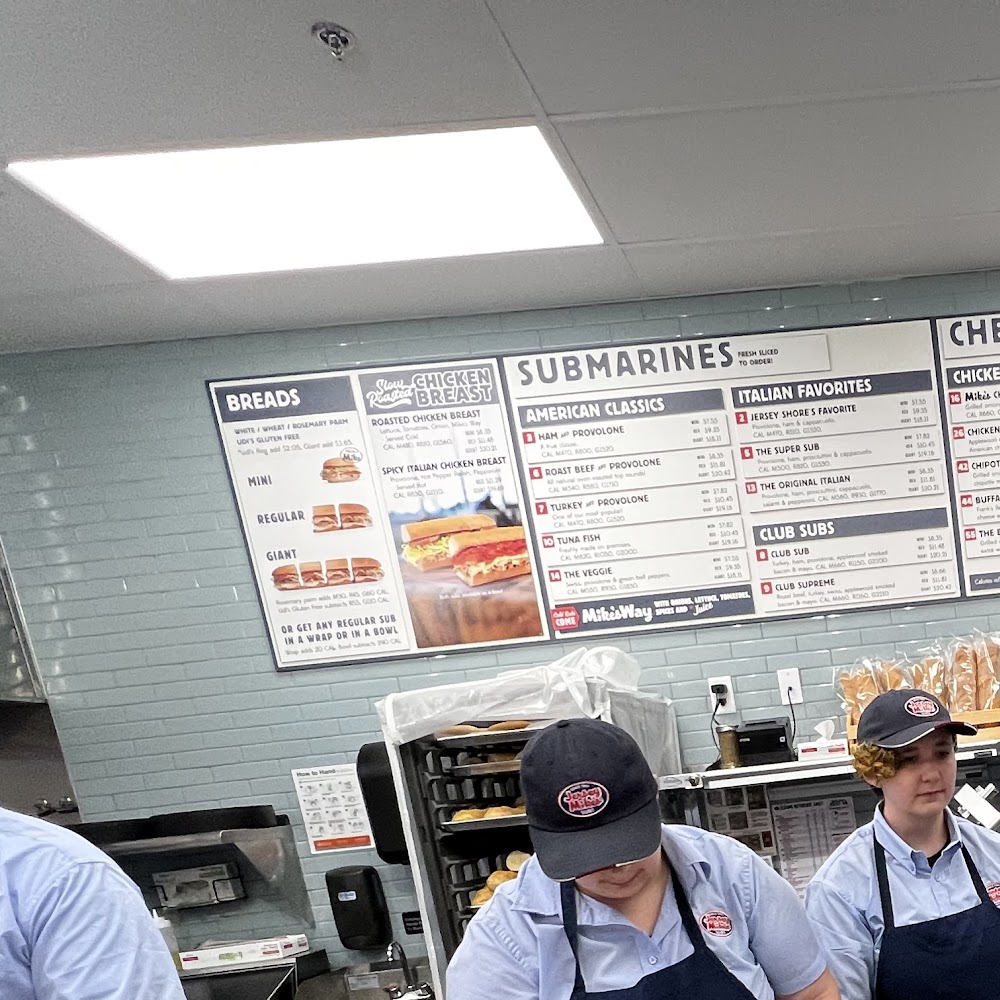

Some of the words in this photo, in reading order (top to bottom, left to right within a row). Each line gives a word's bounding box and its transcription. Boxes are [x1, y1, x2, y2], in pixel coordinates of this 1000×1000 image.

[738, 350, 757, 358] FRESH
[759, 348, 779, 357] SLICED
[517, 341, 733, 386] SUBMARINES
[750, 358, 774, 366] ORDER!
[376, 378, 404, 395] Slow
[412, 368, 491, 390] CHICKEN
[366, 383, 415, 408] Roasted
[415, 384, 492, 407] BREAST
[738, 386, 794, 404] ITALIAN
[798, 378, 872, 399] FAVORITES
[226, 388, 301, 412] BREADS
[371, 415, 410, 427] ROASTED
[412, 412, 448, 423] CHICKEN
[450, 409, 481, 420] BREAST
[526, 404, 601, 423] AMERICAN
[604, 397, 665, 416] CLASSICS
[751, 411, 779, 422] JERSEY
[818, 404, 857, 415] FAVORITE
[234, 427, 255, 435] WHITE
[262, 424, 285, 433] WHEAT
[292, 420, 327, 430] ROSEMARY
[329, 418, 349, 426] PARM
[538, 431, 559, 441] HAM
[572, 426, 625, 438] PROVOLONE
[967, 425, 1000, 436] CHICKEN
[256, 435, 282, 444] GLUTEN
[284, 433, 300, 441] FREE
[755, 447, 773, 456] THE
[774, 445, 801, 455] SUPER
[803, 443, 820, 452] SUB
[382, 466, 404, 475] SPICY
[407, 463, 438, 473] ITALIAN
[440, 459, 474, 470] CHICKEN
[477, 456, 506, 466] BREAST
[545, 466, 572, 477] ROAST
[574, 464, 595, 474] BEEF
[609, 458, 661, 470] PROVOLONE
[247, 475, 273, 487] MINI
[760, 482, 777, 491] THE
[778, 478, 818, 490] ORIGINAL
[820, 475, 851, 486] ITALIAN
[550, 501, 583, 512] TURKEY
[597, 494, 649, 507] PROVOLONE
[257, 510, 306, 524] REGULAR
[557, 536, 580, 545] TUNA
[583, 533, 601, 542] FISH
[759, 525, 796, 542] CLUB
[799, 521, 836, 538] SUBS
[978, 528, 995, 538] THE
[266, 549, 298, 561] GIANT
[771, 549, 792, 558] CLUB
[793, 547, 810, 556] SUB
[564, 570, 580, 579] THE
[582, 567, 613, 577] VEGGIE
[775, 582, 796, 592] CLUB
[797, 578, 836, 589] SUPREME
[281, 624, 293, 634] OR
[296, 622, 313, 633] GET
[316, 620, 333, 631] ANY
[336, 617, 377, 629] REGULAR
[379, 614, 397, 624] SUB
[555, 617, 577, 627] COME
[284, 636, 294, 646] IN
[298, 635, 304, 644] A
[306, 632, 333, 643] WRAP
[336, 631, 348, 640] OR
[351, 629, 361, 639] IN
[364, 628, 371, 637] A
[373, 626, 399, 636] BOWL
[563, 787, 602, 803] Jersey
